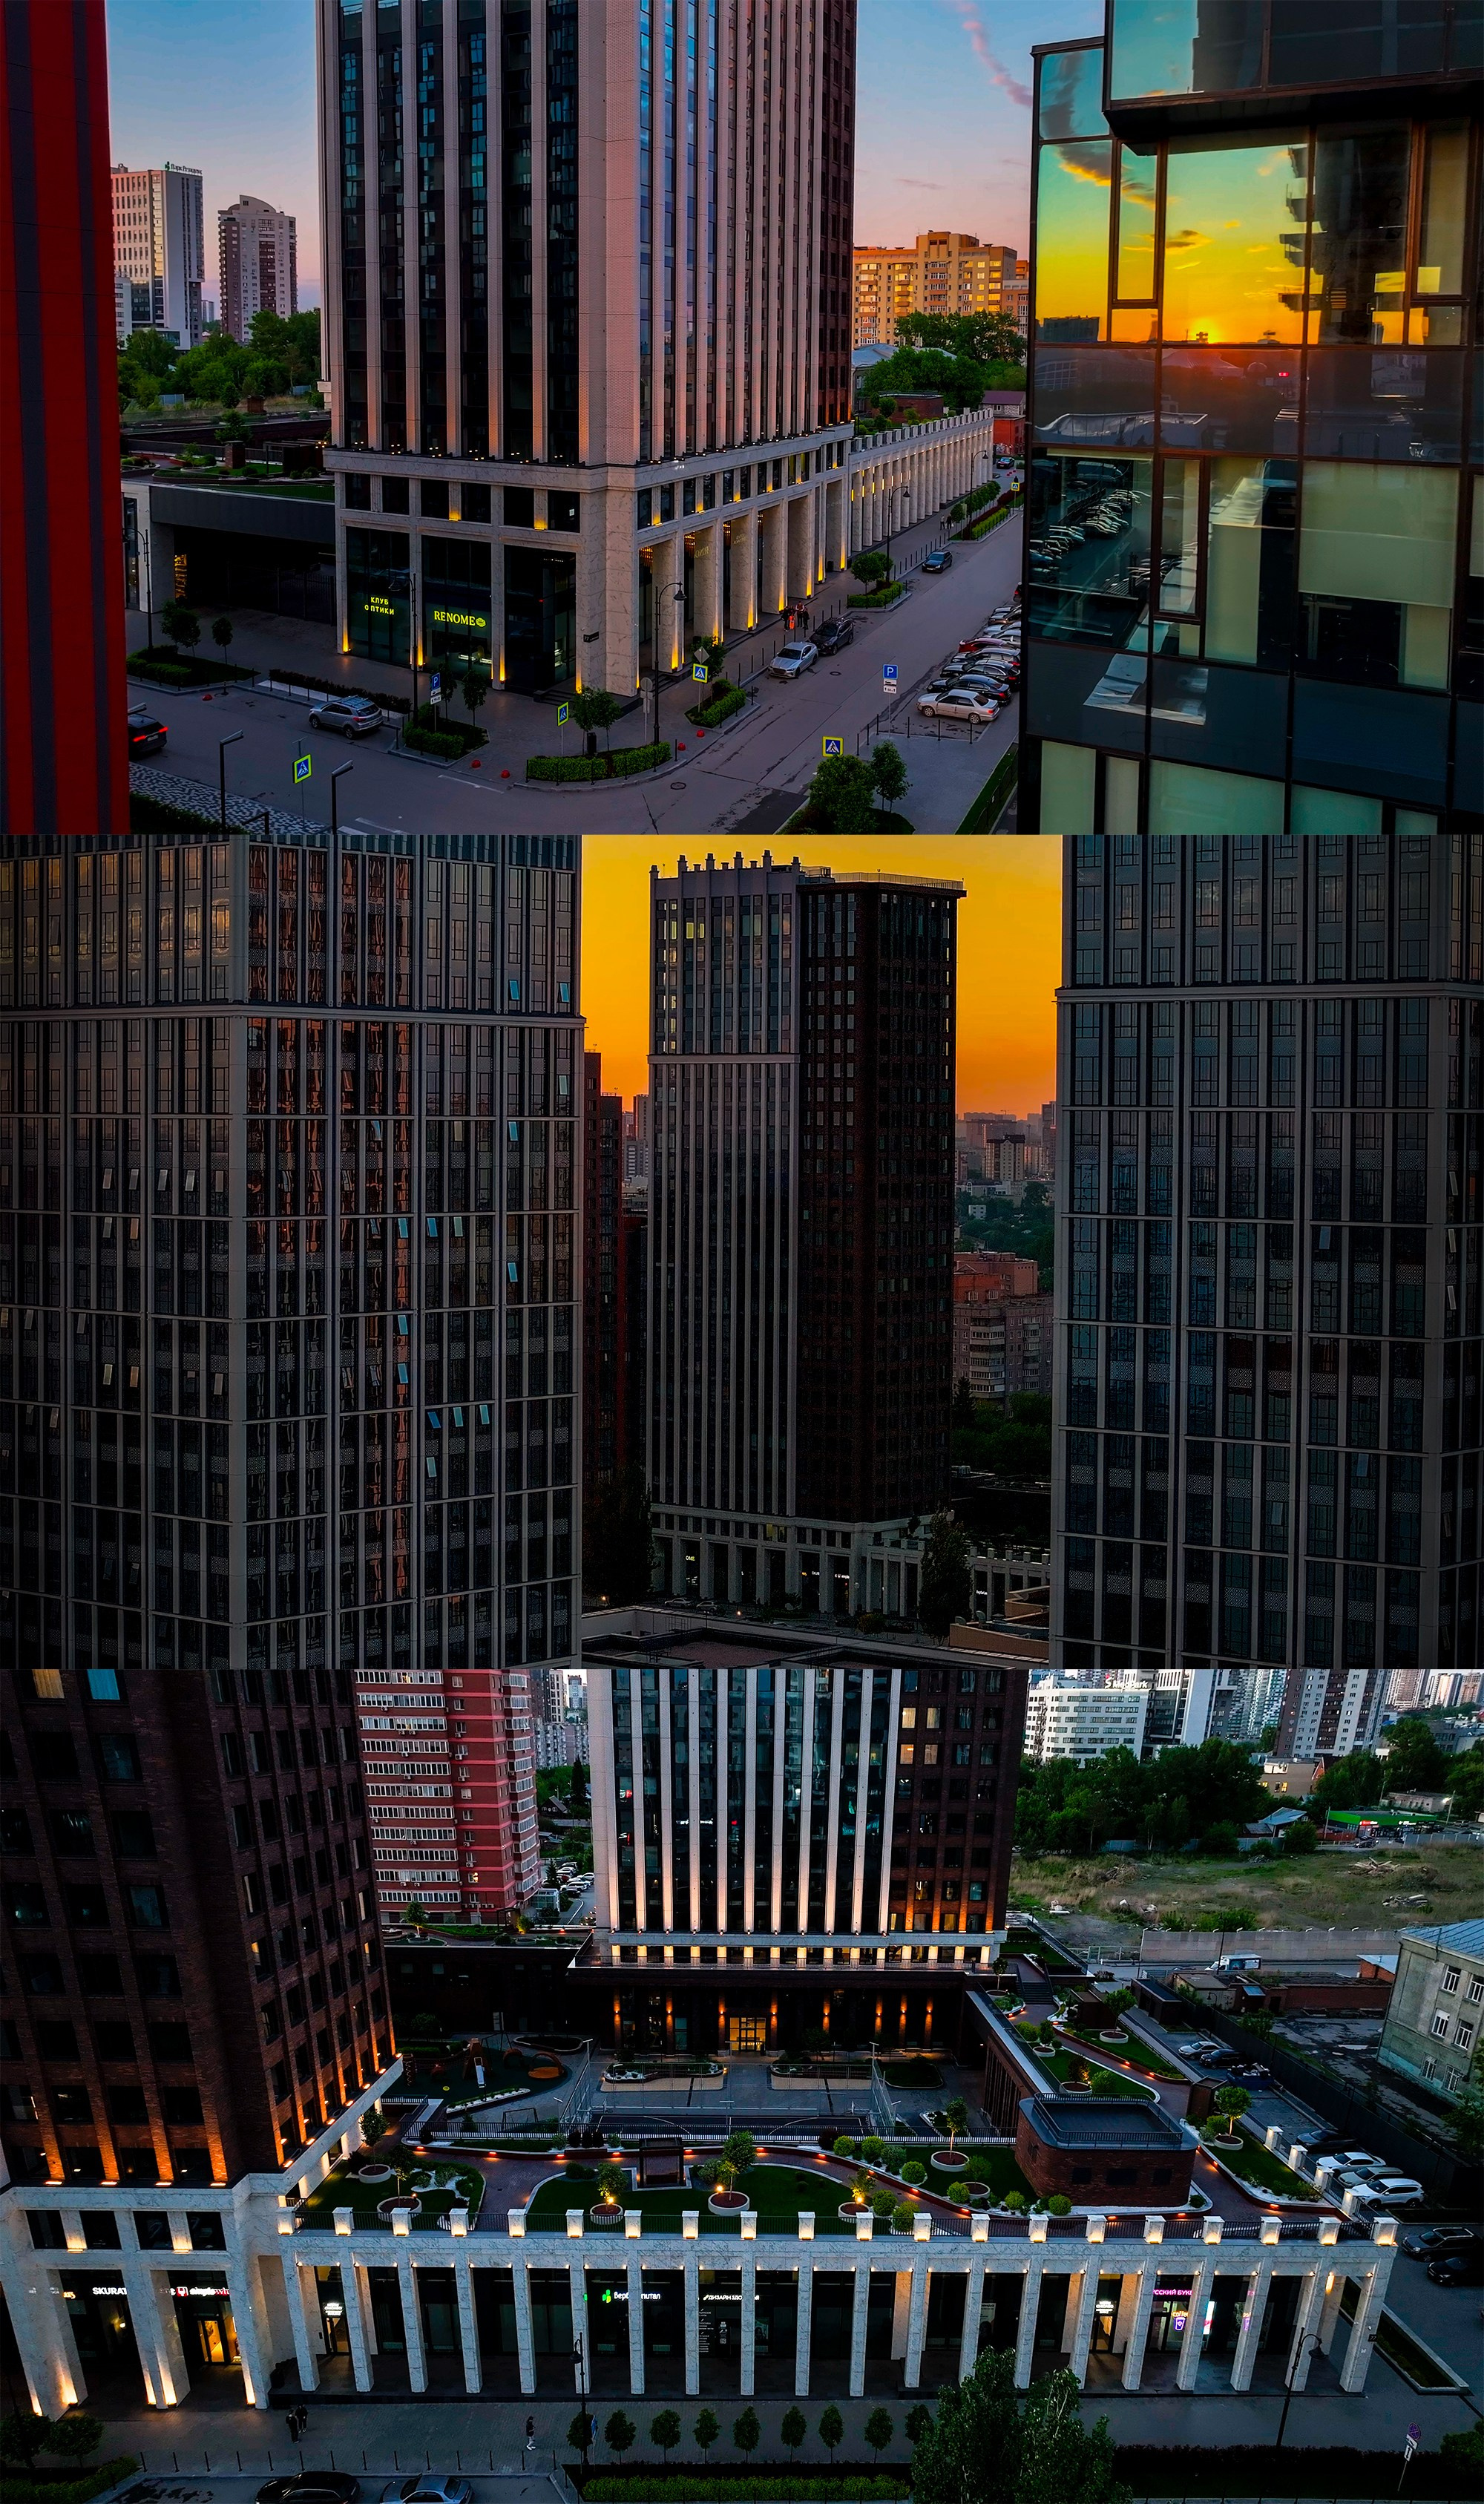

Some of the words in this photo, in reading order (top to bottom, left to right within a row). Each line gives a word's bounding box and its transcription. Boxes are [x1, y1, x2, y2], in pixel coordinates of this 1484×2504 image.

[371, 597, 389, 605] КЛУБ
[364, 604, 395, 615] ОПТИКИ
[434, 610, 476, 626] RENOME
[887, 667, 893, 676] P
[434, 676, 439, 686] P
[1113, 1679, 1149, 1689] MedPark
